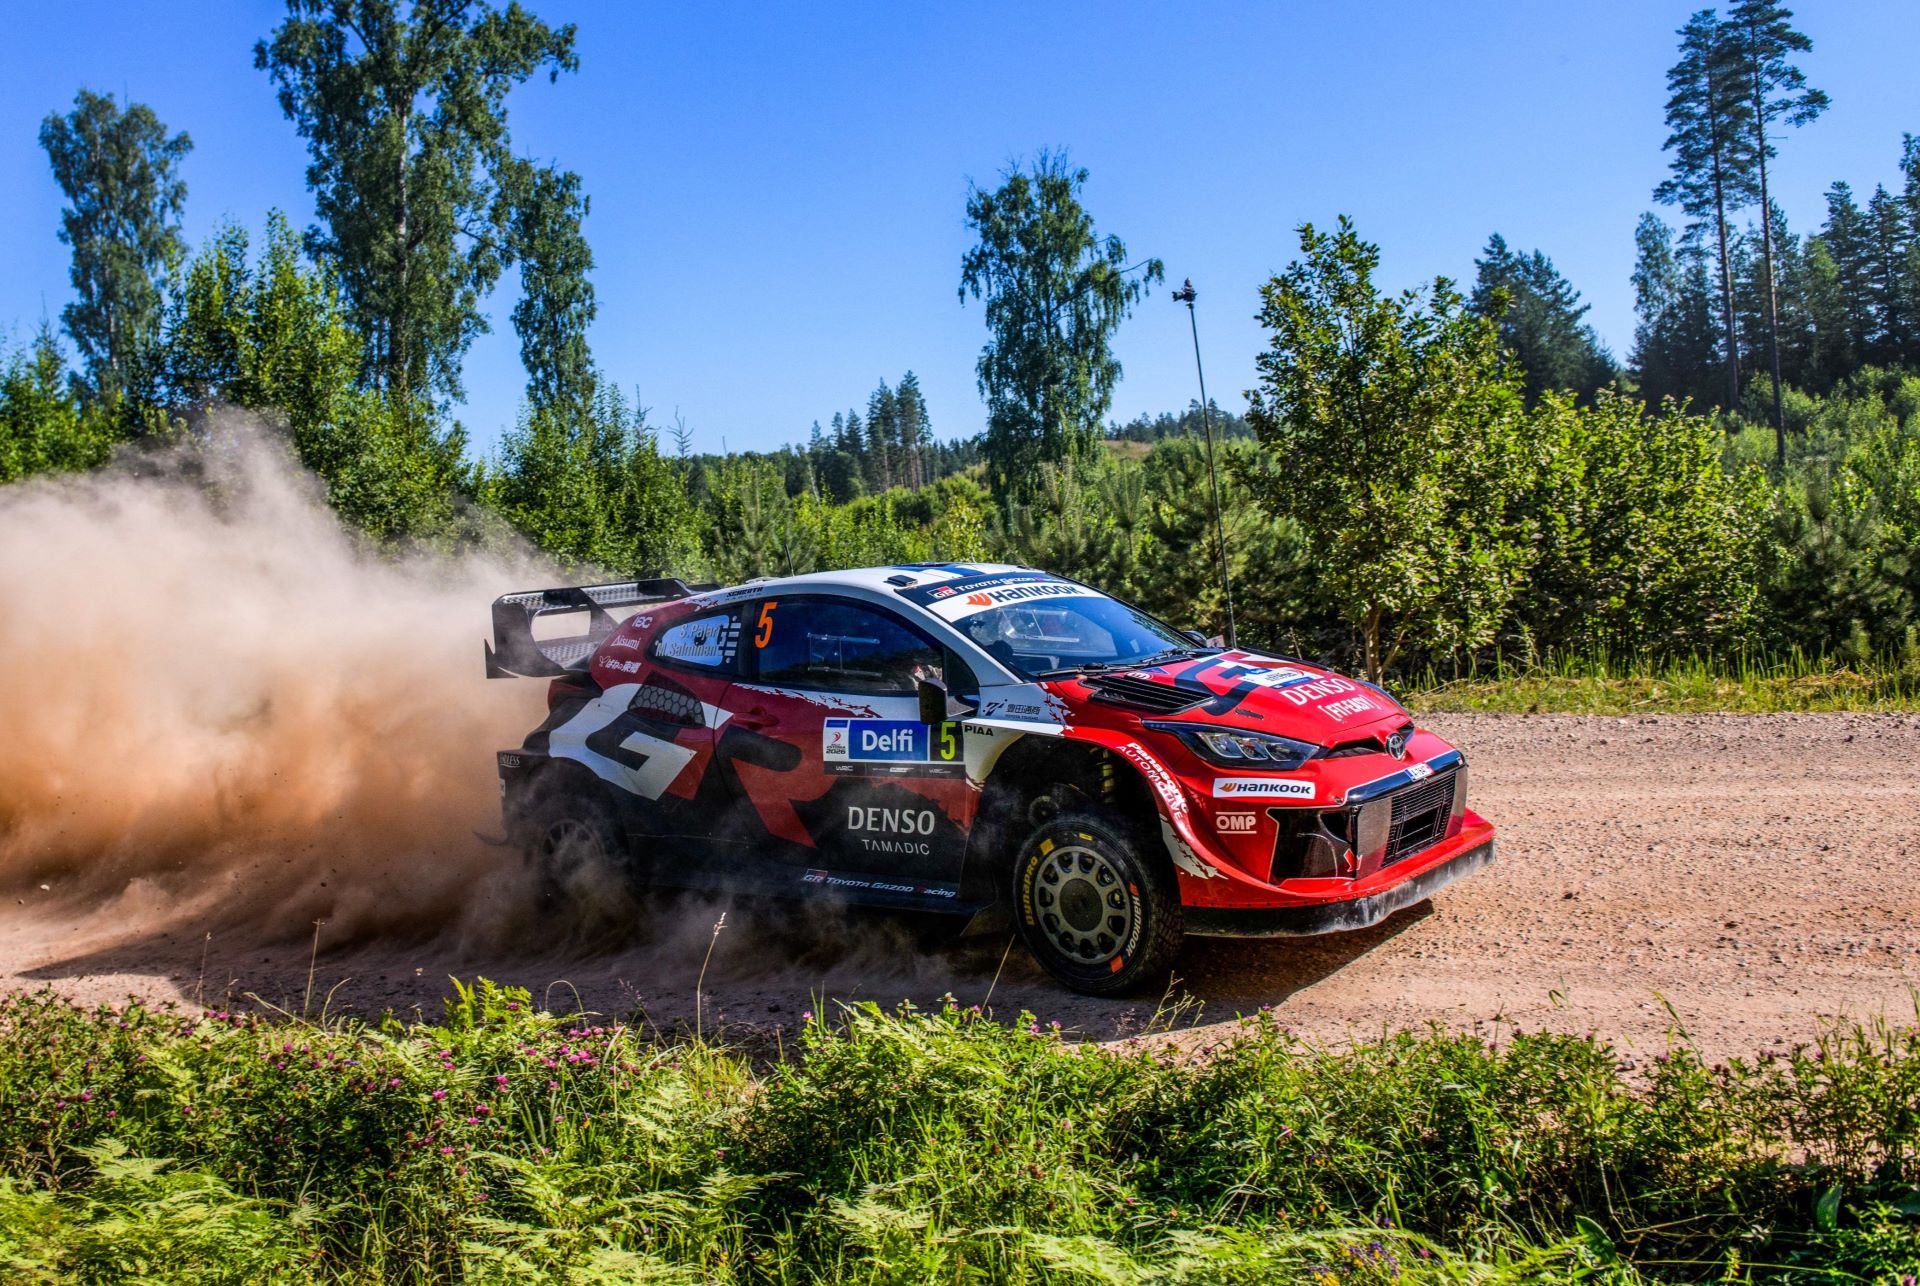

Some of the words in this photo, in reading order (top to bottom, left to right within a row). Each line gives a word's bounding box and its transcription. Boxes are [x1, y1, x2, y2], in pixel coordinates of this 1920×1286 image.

[955, 580, 1000, 592] TOYOTA
[754, 602, 778, 649] 5
[1279, 678, 1356, 706] DENSO
[862, 728, 914, 752] Delfi
[964, 724, 994, 737] PIAA
[940, 721, 957, 761] 5
[847, 806, 936, 836] DENSO
[1216, 815, 1257, 831] OMP
[861, 839, 931, 856] TAMADIC
[826, 876, 871, 889] TOYOTA
[871, 882, 915, 893] GAZOO
